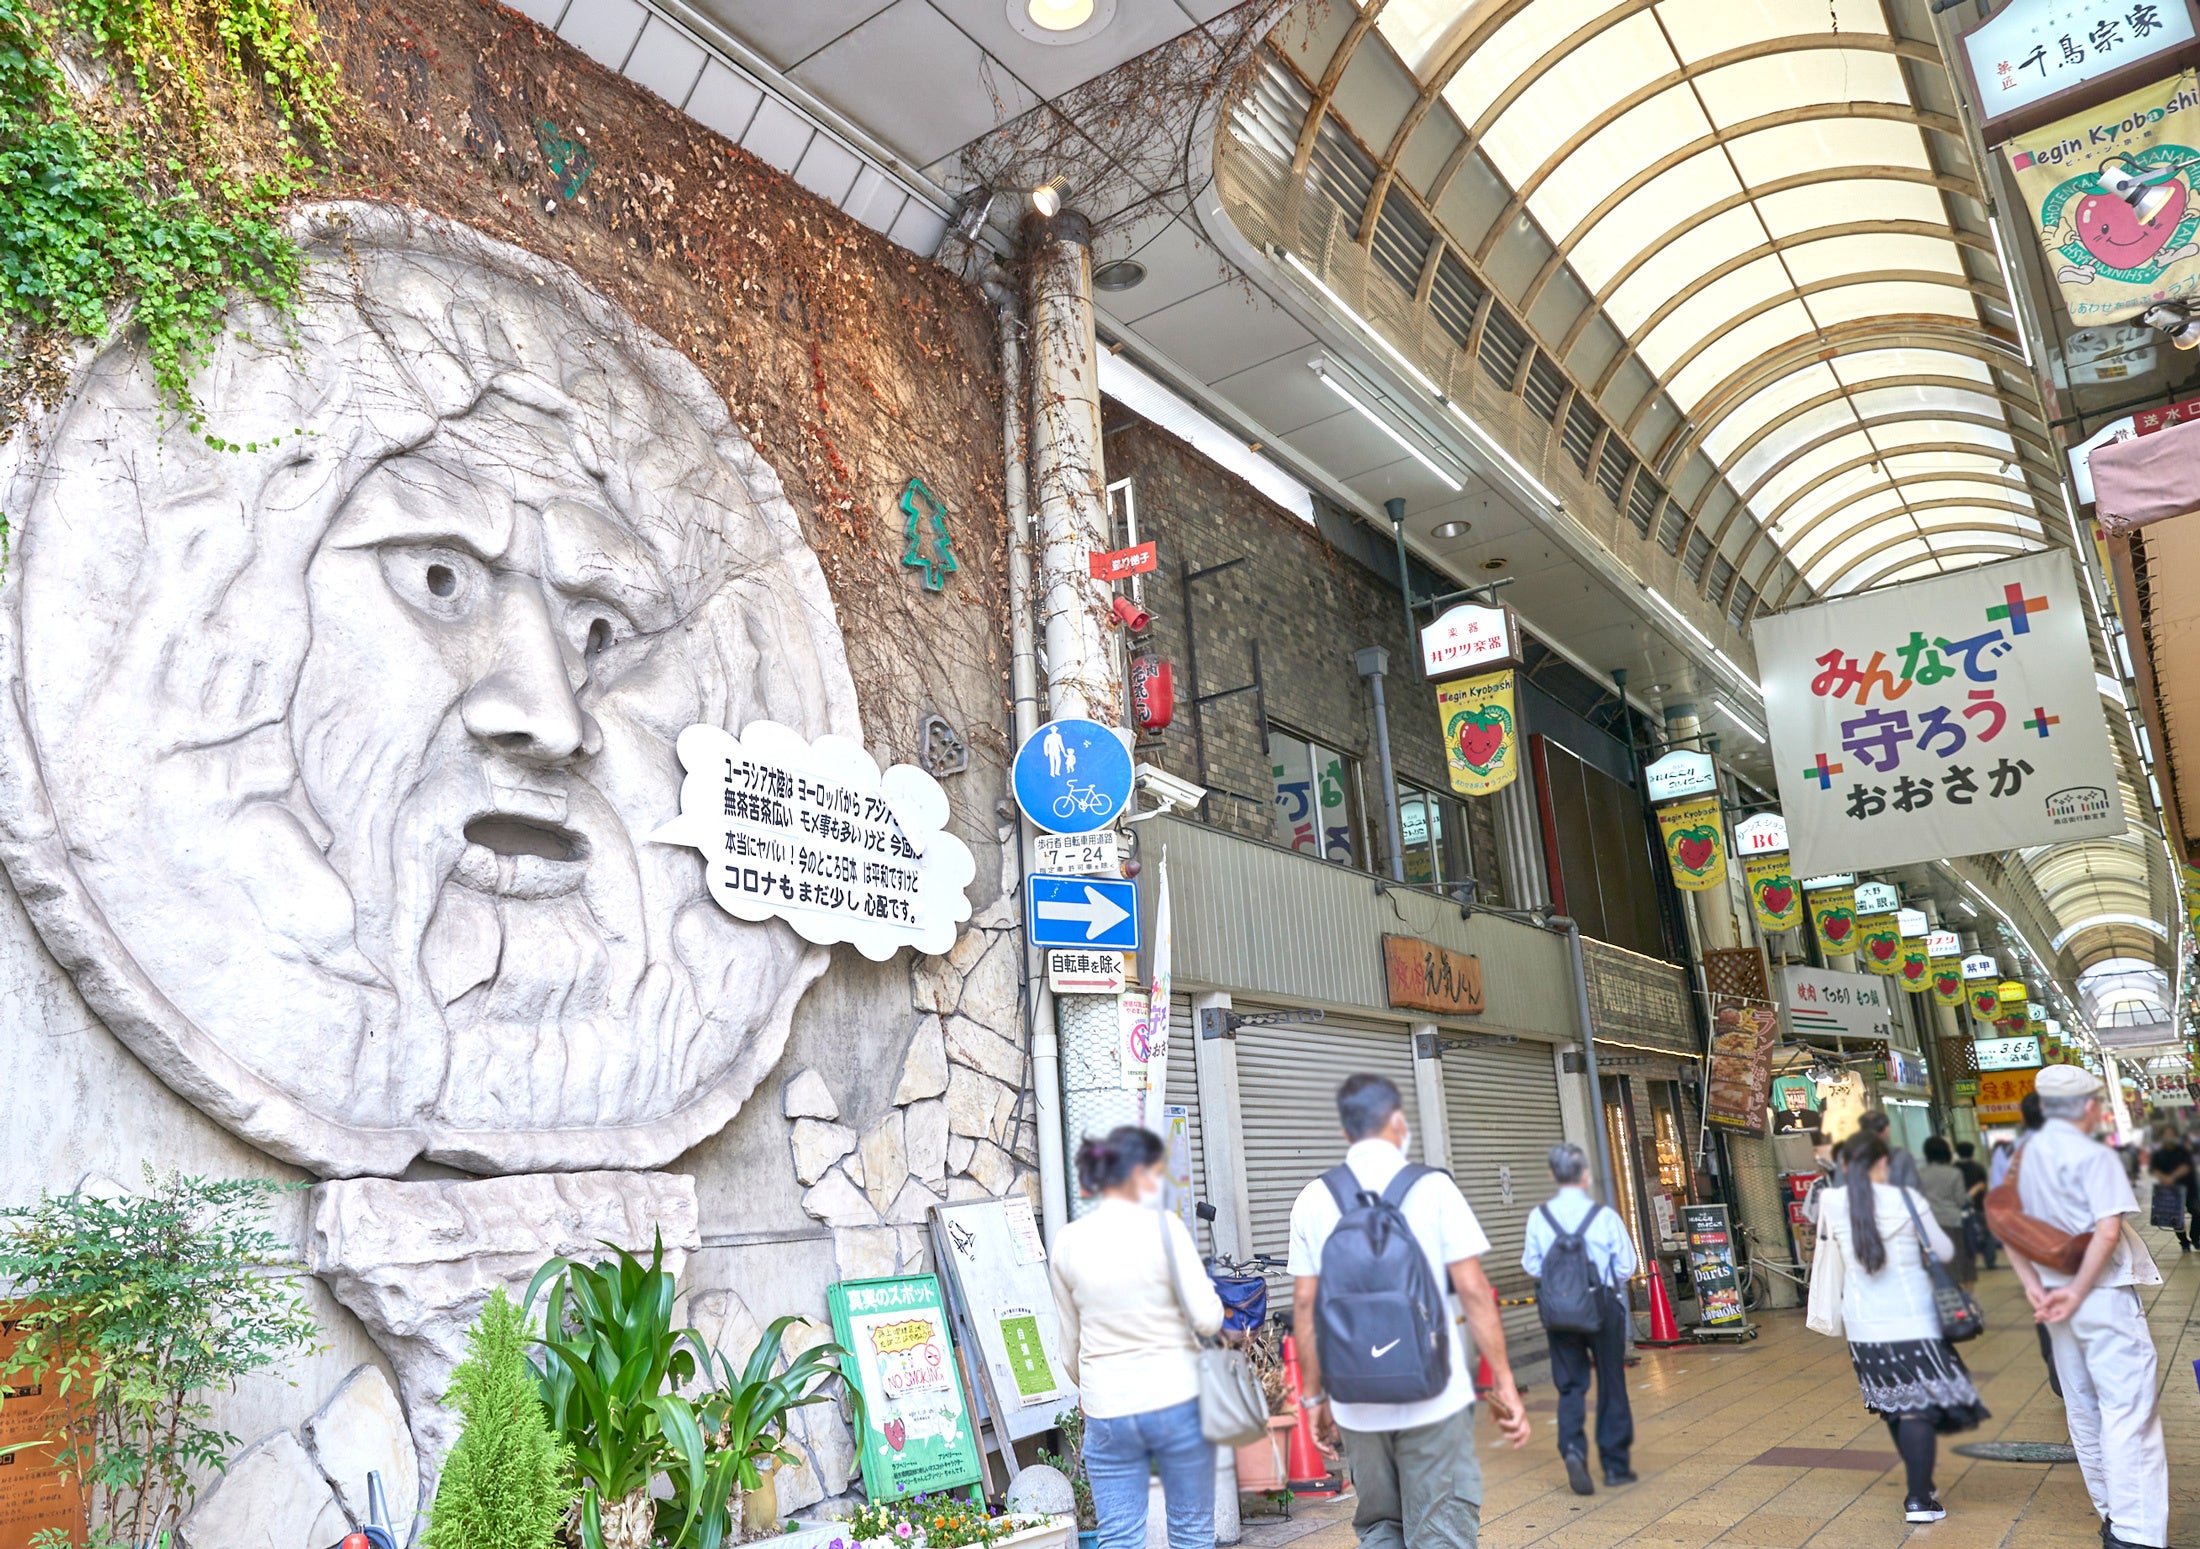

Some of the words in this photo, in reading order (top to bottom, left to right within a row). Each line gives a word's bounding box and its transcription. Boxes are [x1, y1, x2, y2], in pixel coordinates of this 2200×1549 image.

[2018, 4, 2163, 77] 千鳥宗家
[2143, 402, 2200, 428] 送水口
[1811, 629, 2012, 705] みんなで
[1841, 689, 2007, 772] 守ろう
[724, 758, 793, 799] ユーラシア大陸は
[1846, 758, 2034, 820] おおさか
[724, 787, 793, 828] 無茶苦茶広い
[1038, 837, 1062, 850] 歩行者
[1064, 833, 1113, 848] 自転車用道路
[1752, 832, 1780, 849] BC
[725, 865, 794, 900] コロナも
[864, 892, 916, 924] 心配です。
[1052, 953, 1122, 974] 自転車を除く
[1694, 1266, 1731, 1283] Darts
[887, 1373, 903, 1389] NO
[904, 1366, 944, 1386] SMOKING
